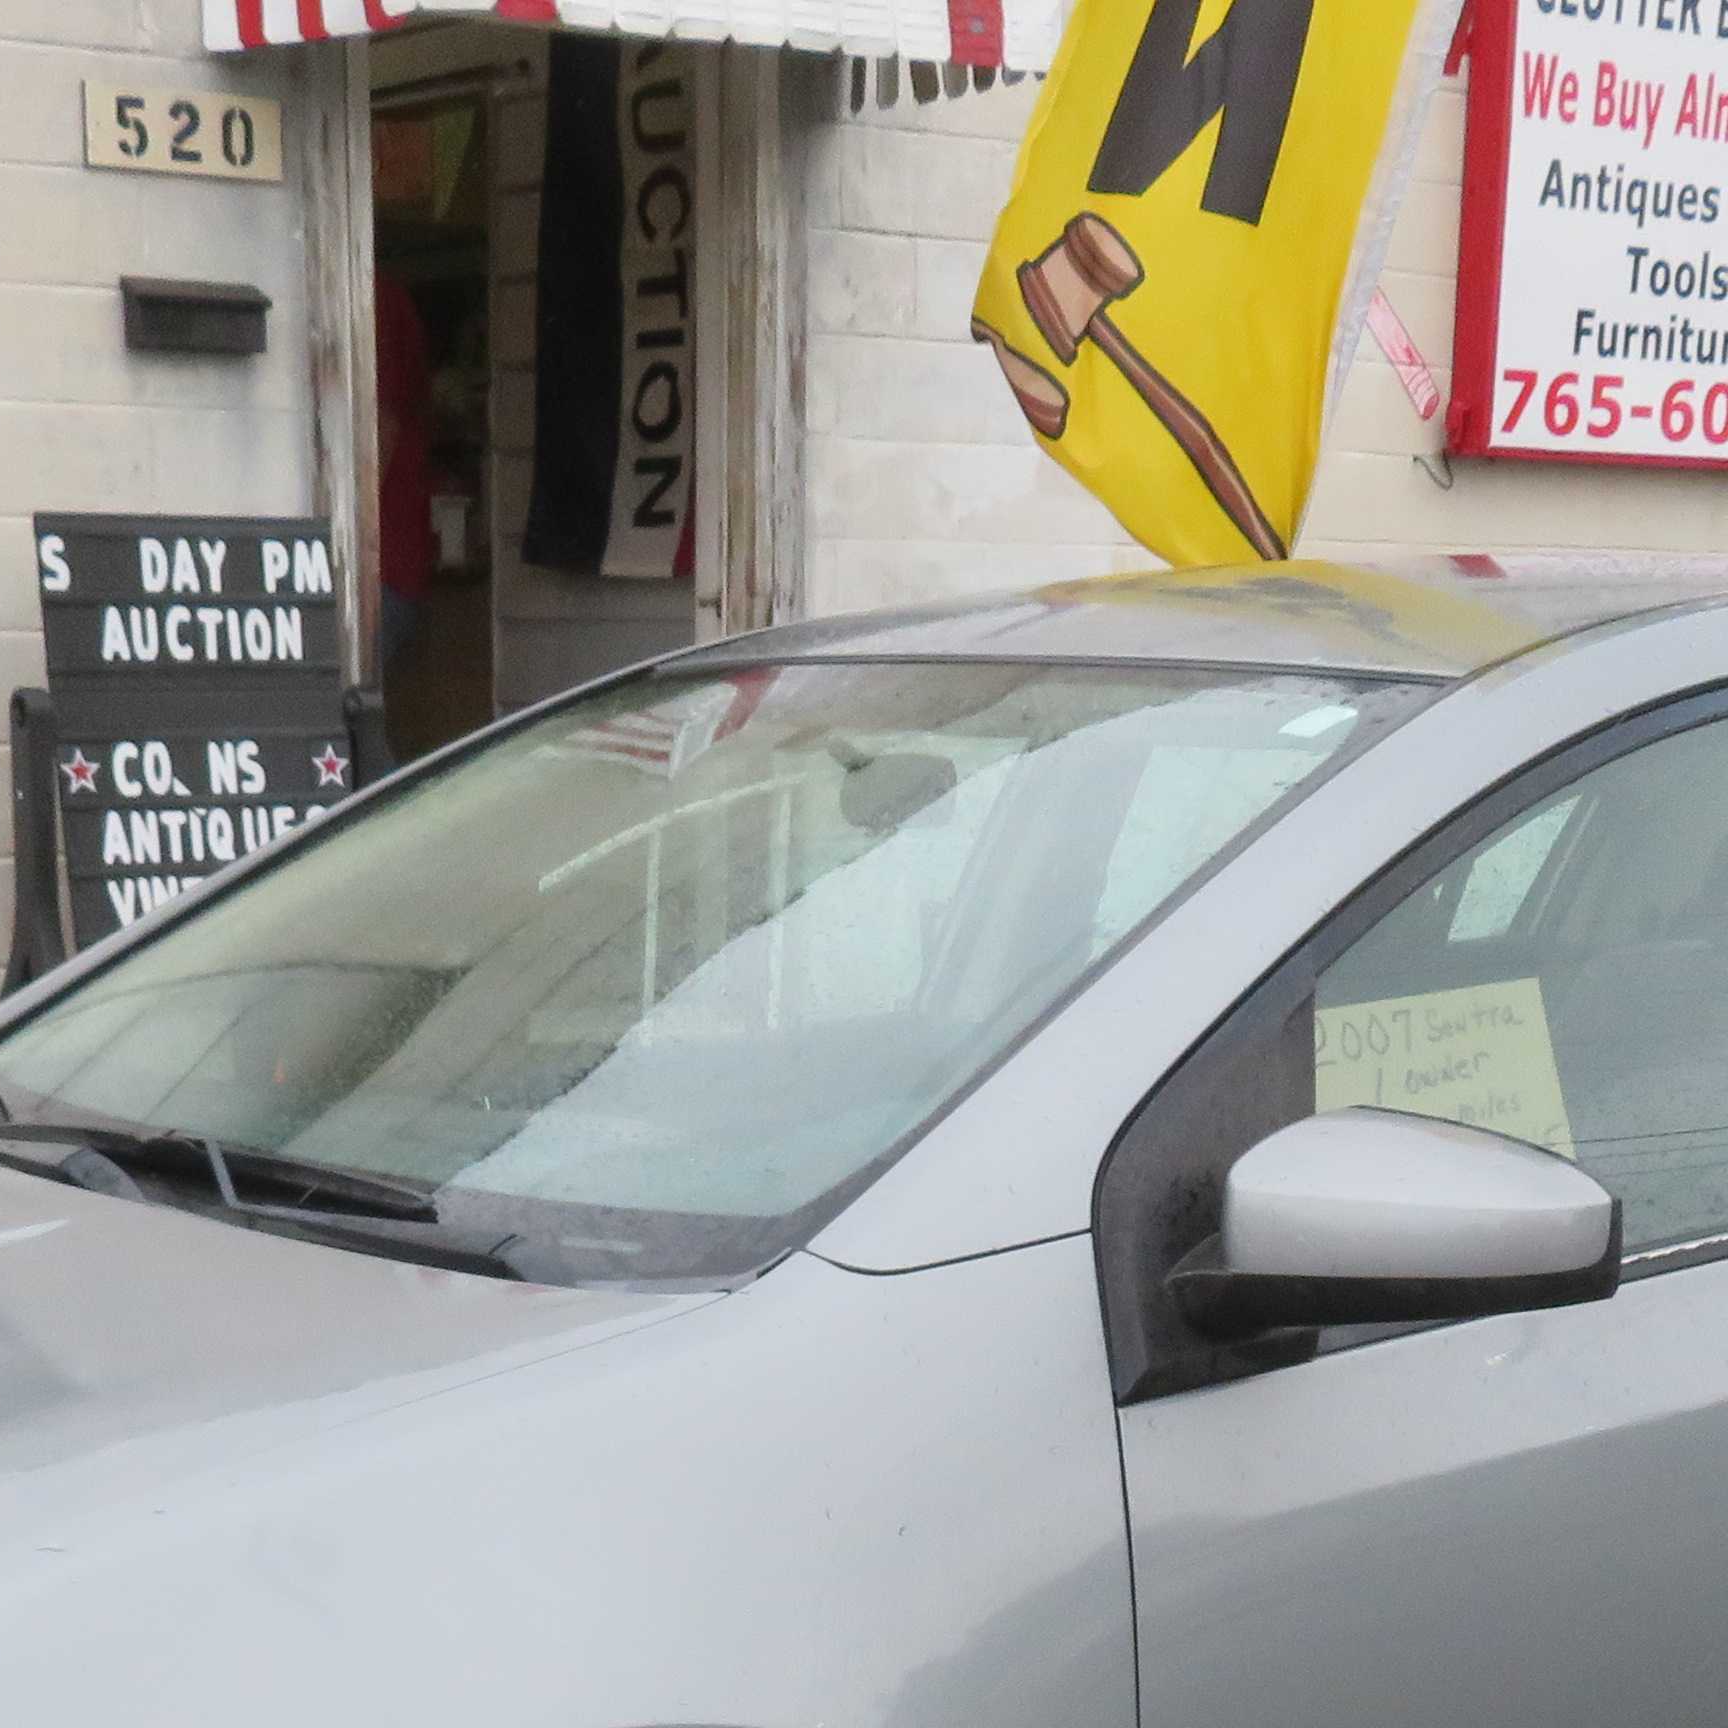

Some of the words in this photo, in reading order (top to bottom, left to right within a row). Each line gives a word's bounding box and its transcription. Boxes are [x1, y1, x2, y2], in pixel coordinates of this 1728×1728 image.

[1522, 50, 1579, 124] We
[1592, 60, 1665, 150] Buy
[115, 96, 256, 168] 520
[1538, 158, 1720, 229] Antiques
[139, 537, 227, 594] DAY
[261, 538, 333, 594] PM
[101, 605, 304, 662] AUCTION
[102, 804, 326, 865] ANTIQUE
[106, 875, 209, 928] VIN
